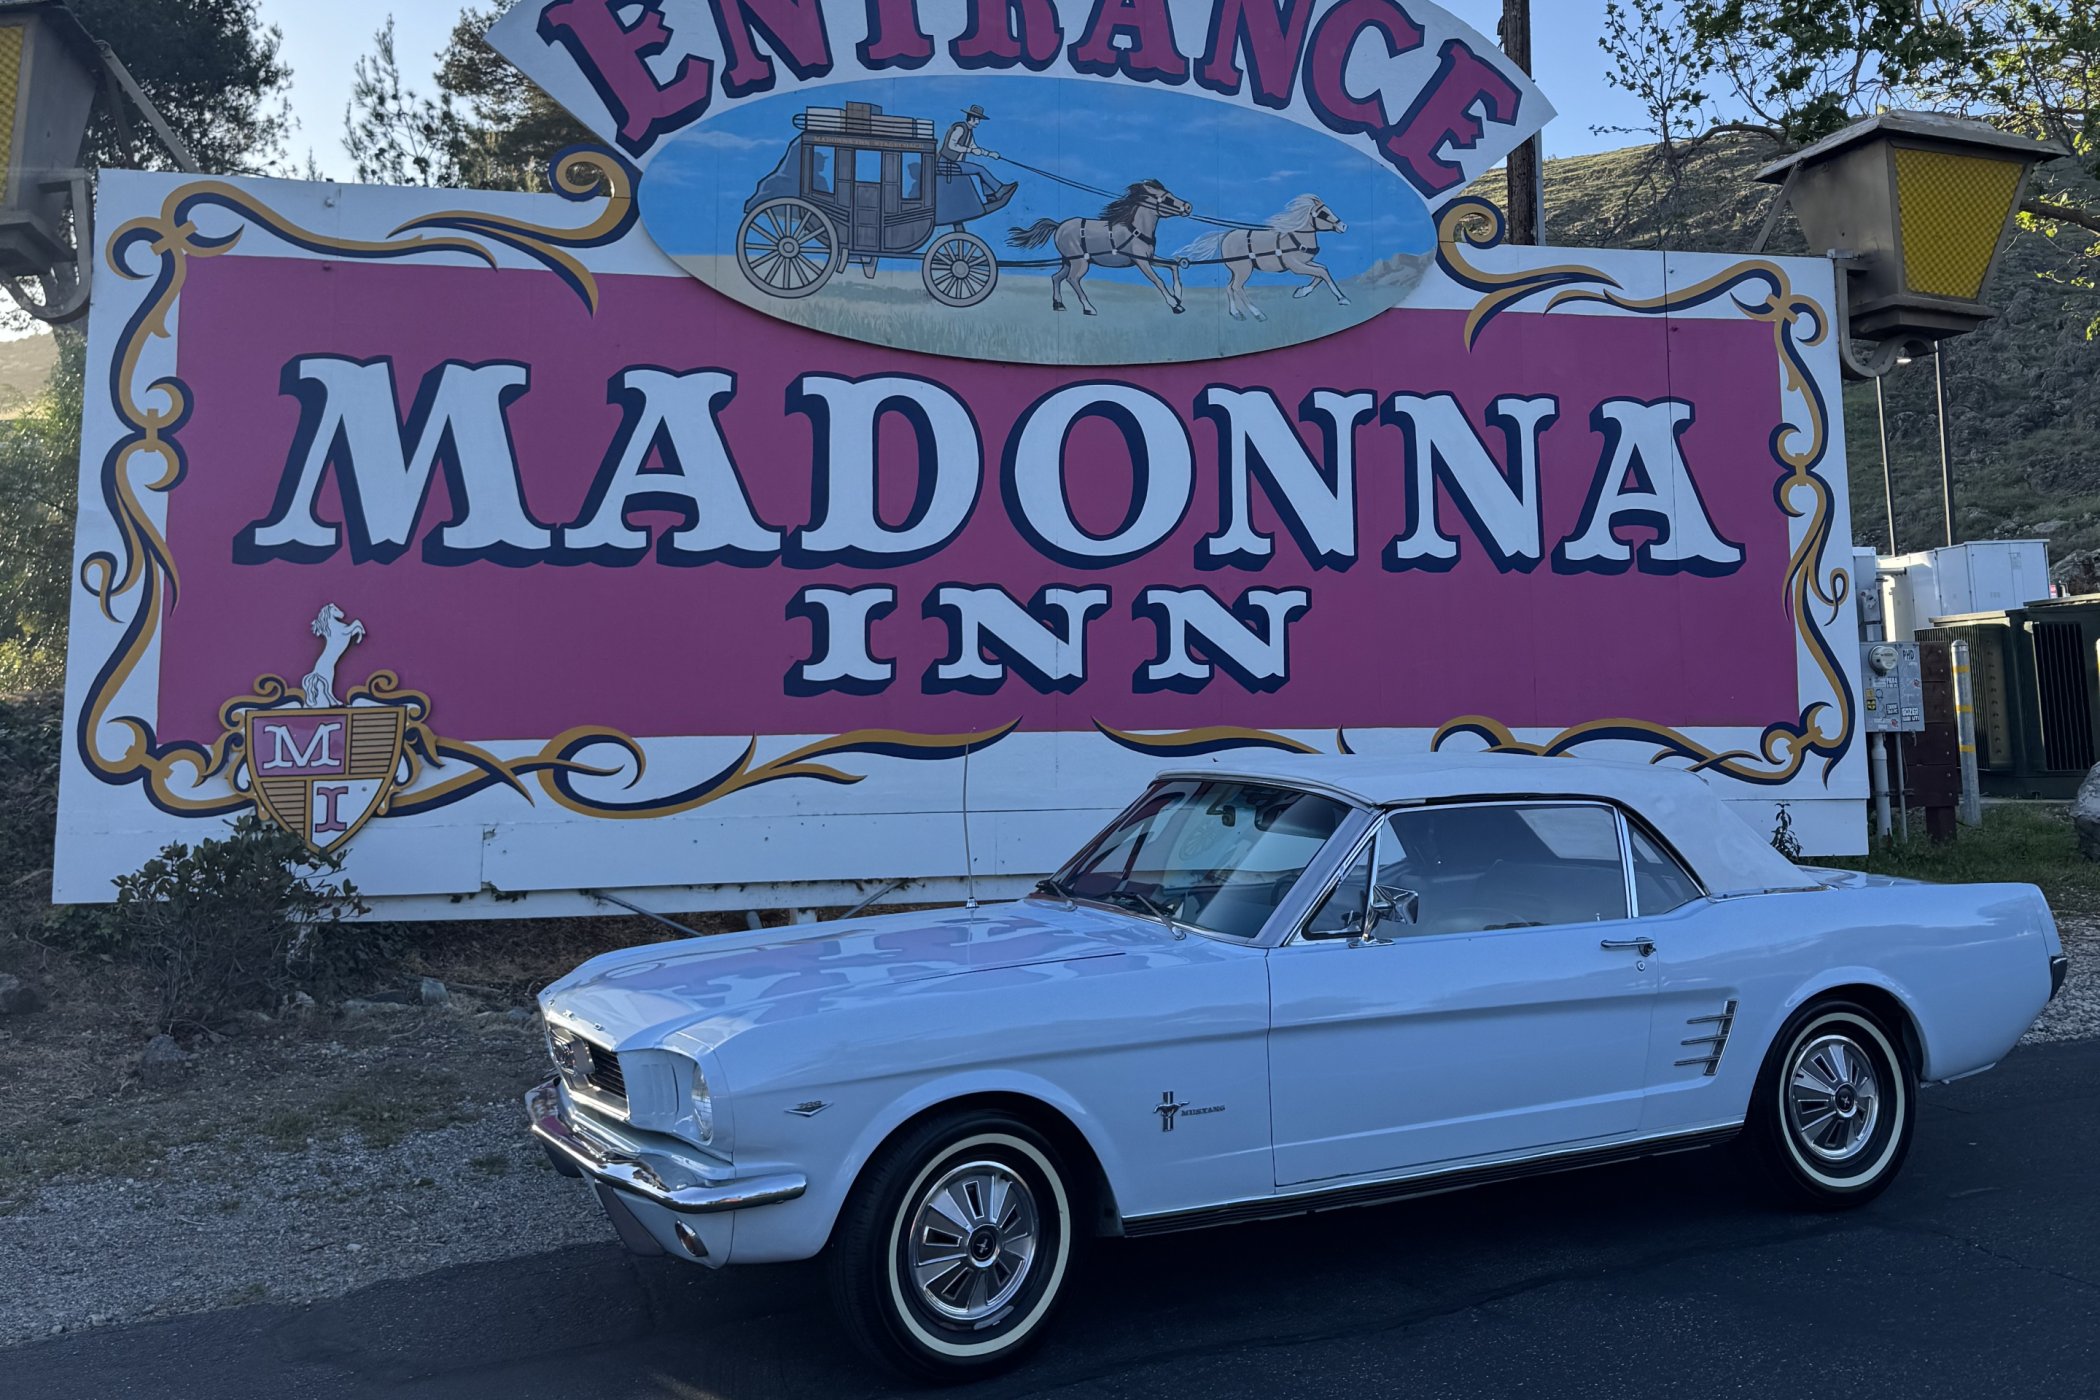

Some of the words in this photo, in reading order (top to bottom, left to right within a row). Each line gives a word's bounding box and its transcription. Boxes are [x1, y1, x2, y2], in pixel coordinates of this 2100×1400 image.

[232, 352, 1746, 577] MADONNA
[784, 584, 1312, 695] INN
[263, 722, 342, 770] M
[315, 785, 349, 833] I
[1181, 1105, 1226, 1116] MUSTANG
